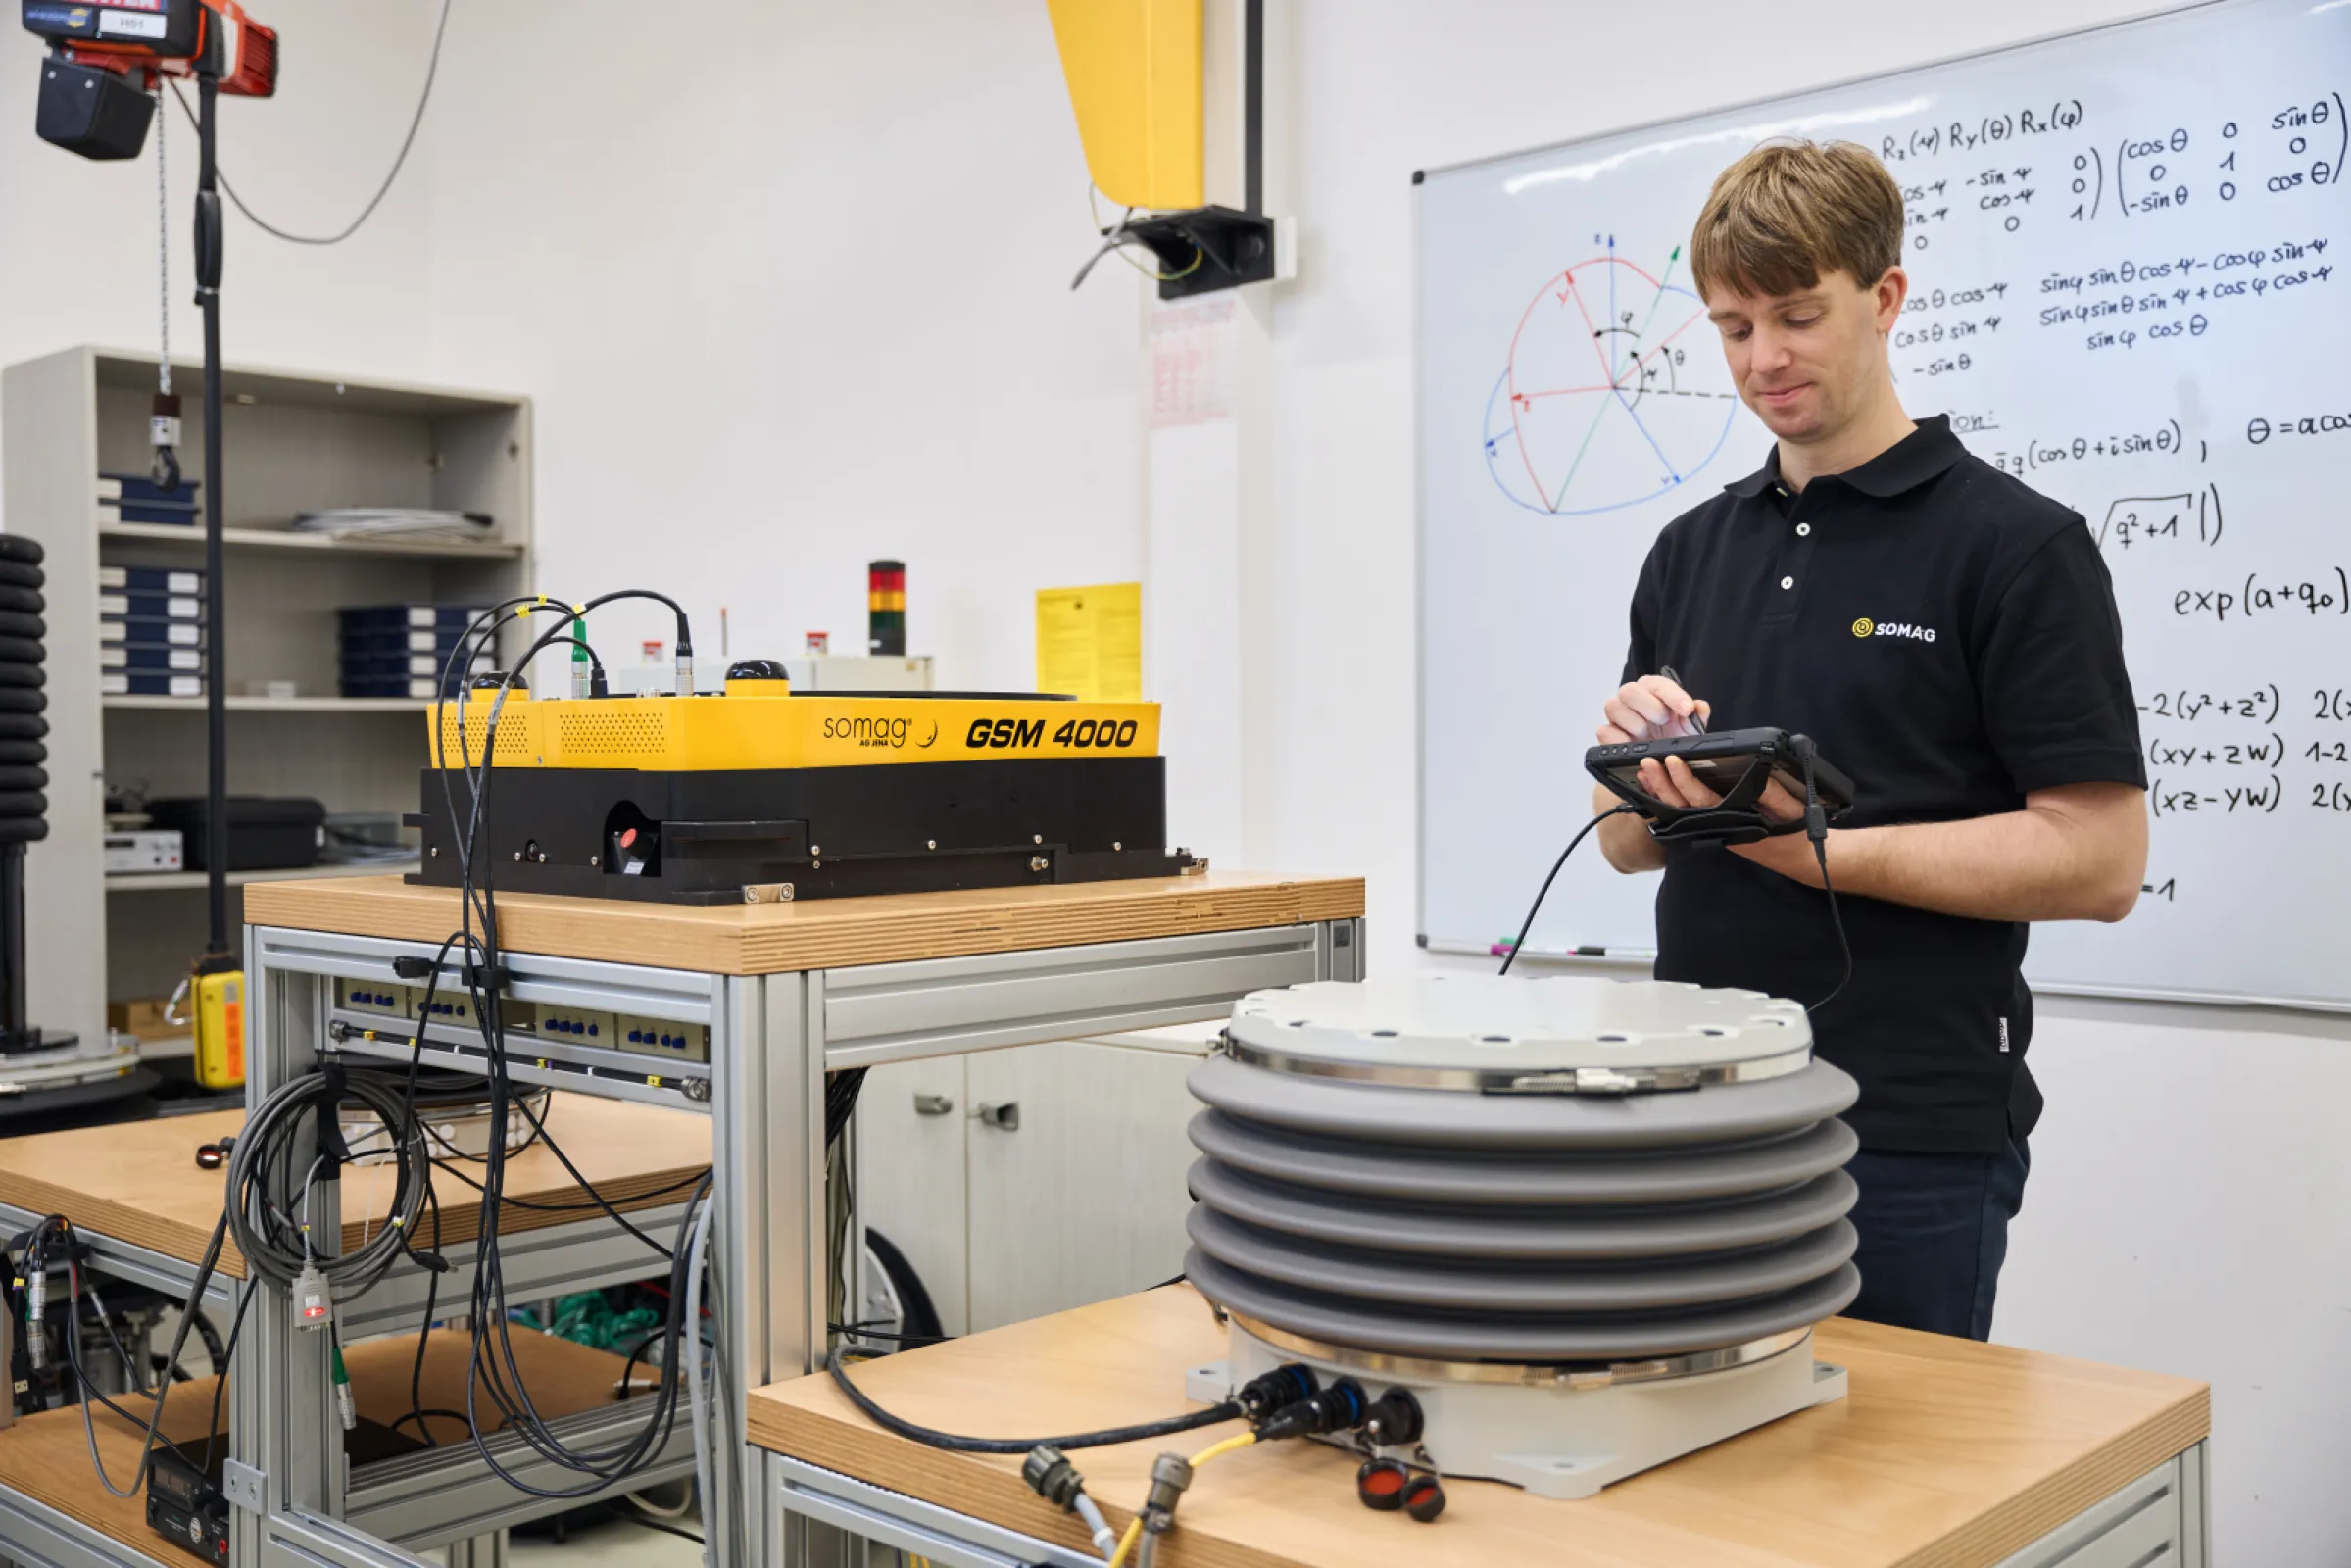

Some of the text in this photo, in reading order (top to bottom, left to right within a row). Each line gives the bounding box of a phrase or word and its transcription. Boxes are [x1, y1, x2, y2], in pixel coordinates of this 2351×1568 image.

[1875, 622, 1936, 643] SOMAG
[965, 719, 1046, 749] GSM
[1053, 719, 1139, 748] 4000
